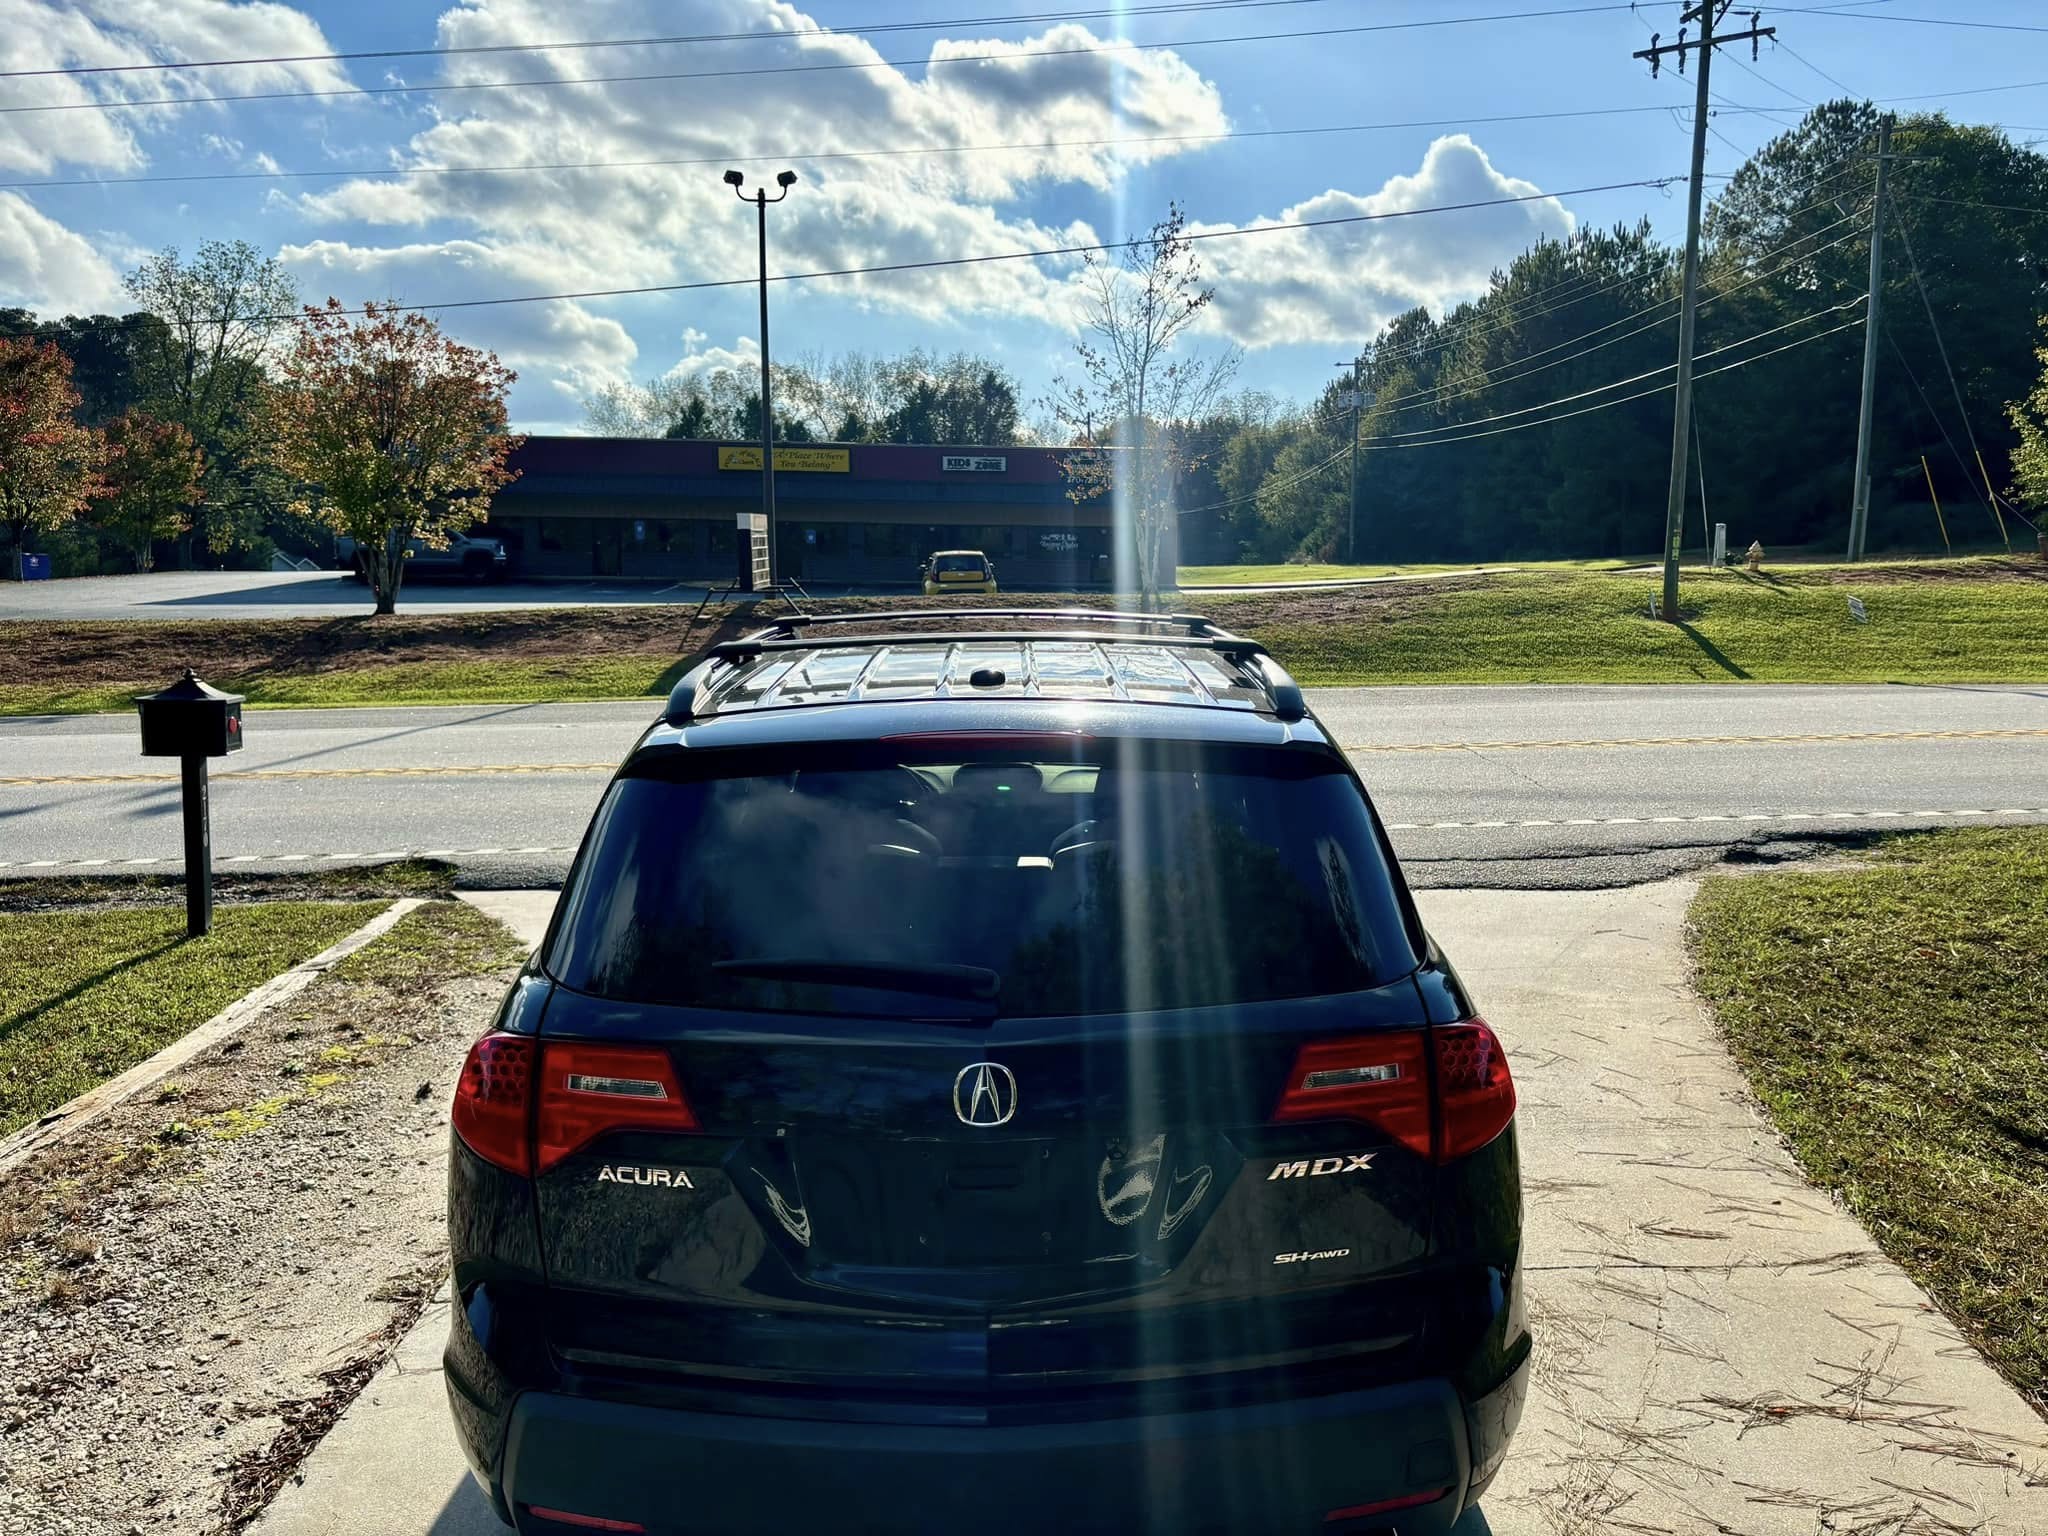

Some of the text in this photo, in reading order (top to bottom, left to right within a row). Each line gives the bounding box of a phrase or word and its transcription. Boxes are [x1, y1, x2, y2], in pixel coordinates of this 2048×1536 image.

[947, 458, 1002, 470] KIDS ZONE
[597, 1164, 695, 1189] ACURA
[1266, 1152, 1378, 1181] MDX
[1273, 1248, 1350, 1264] SH-AWD
